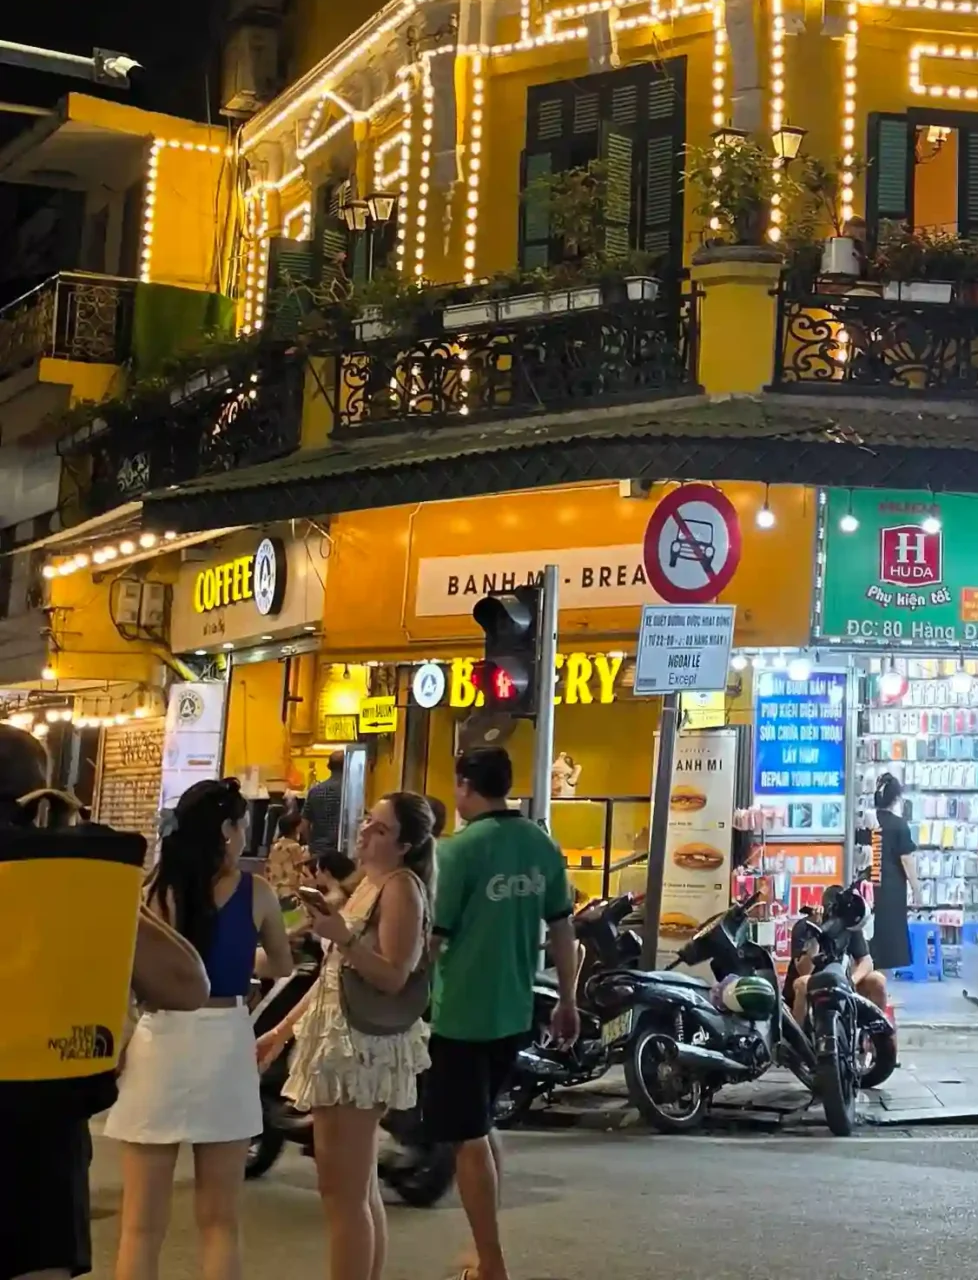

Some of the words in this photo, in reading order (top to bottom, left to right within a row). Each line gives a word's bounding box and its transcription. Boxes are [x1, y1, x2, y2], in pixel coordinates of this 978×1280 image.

[194, 555, 254, 613] COFFEE
[581, 564, 648, 589] BREA
[882, 620, 903, 638] 80
[911, 620, 956, 641] Hàng
[449, 652, 624, 708] BERY
[668, 672, 697, 686] Except
[675, 759, 702, 771] ANH
[486, 865, 546, 902] Grab
[47, 1037, 94, 1050] NORTH
